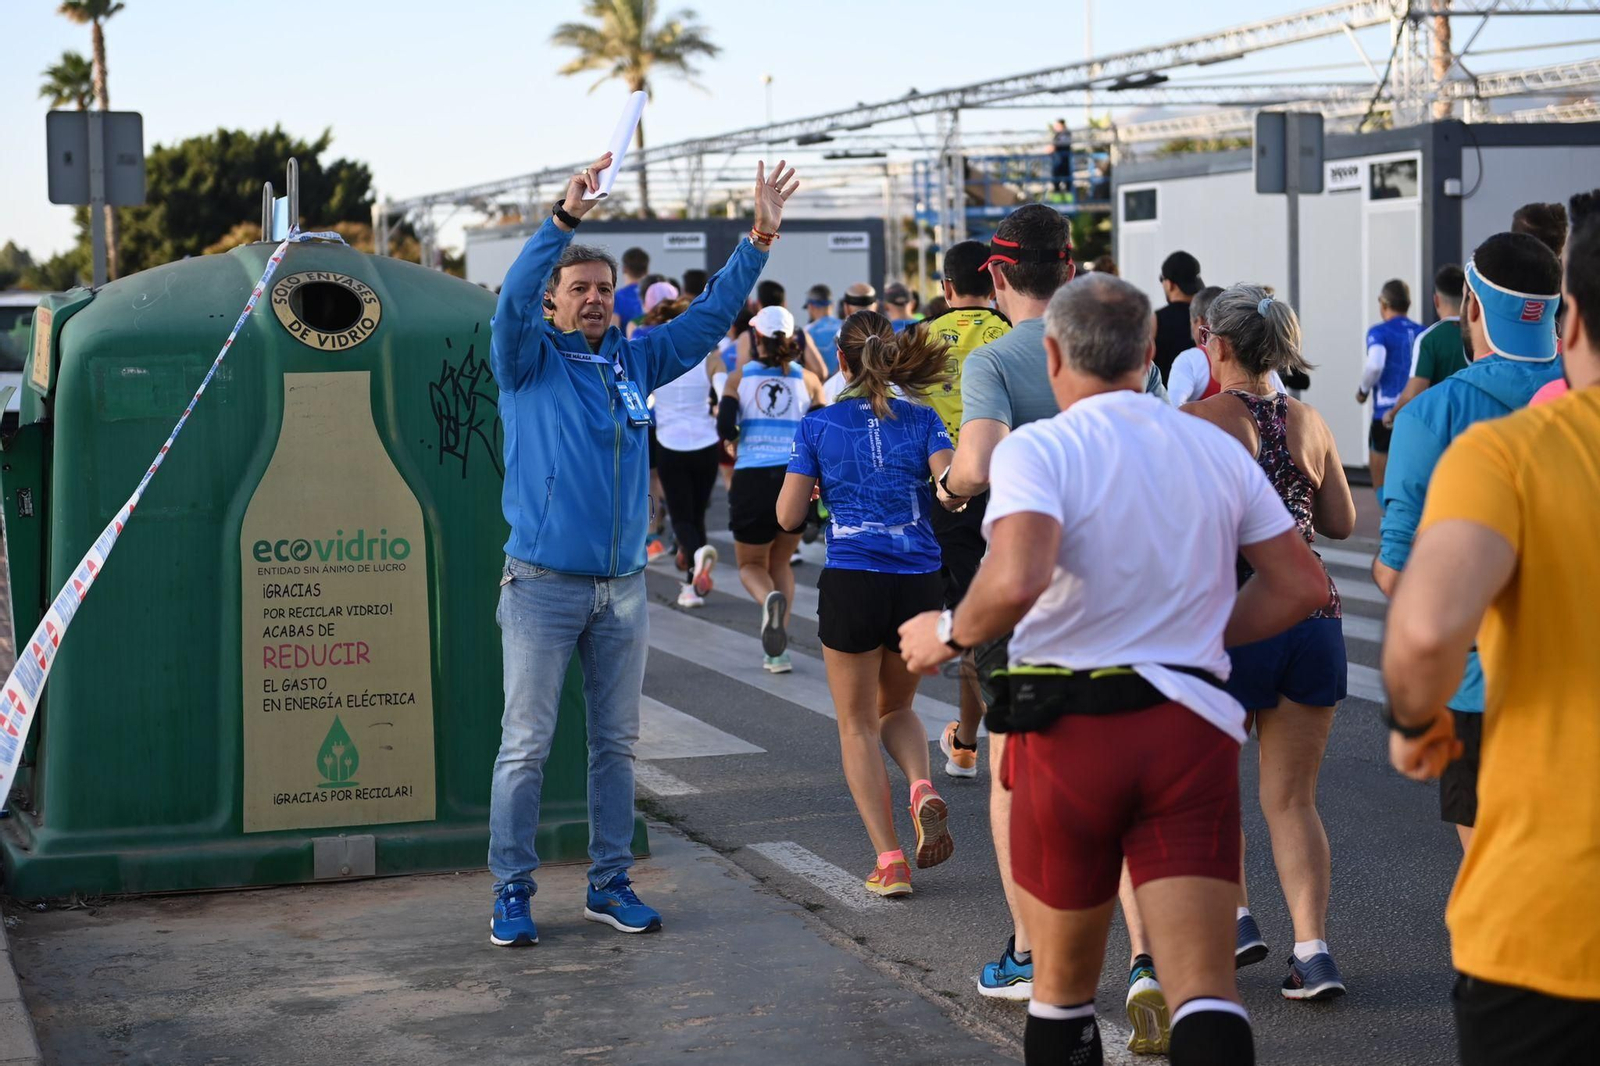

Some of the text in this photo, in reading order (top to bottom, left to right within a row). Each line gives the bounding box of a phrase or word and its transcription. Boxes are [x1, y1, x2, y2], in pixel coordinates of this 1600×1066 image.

[274, 276, 301, 305] SOLO
[306, 273, 376, 304] ENVASES
[288, 318, 374, 348] DE VIDRIO
[867, 418, 879, 428] 31
[253, 528, 411, 563] ecovidrio
[258, 563, 406, 576] ENTIDAD SIN ÁNIMO DE LUCRO
[263, 583, 321, 599] ¡GRACIAS
[263, 603, 393, 619] POR RECICLAR VIDRIO!
[263, 623, 335, 638] ACABAS DE
[263, 641, 371, 669] REDUCIR
[263, 677, 327, 693] EL GASTO
[263, 689, 416, 712] EN ENERGÍA ELÉCTRICA
[273, 785, 413, 805] ¡GRACIAS POR RECICLAR!
